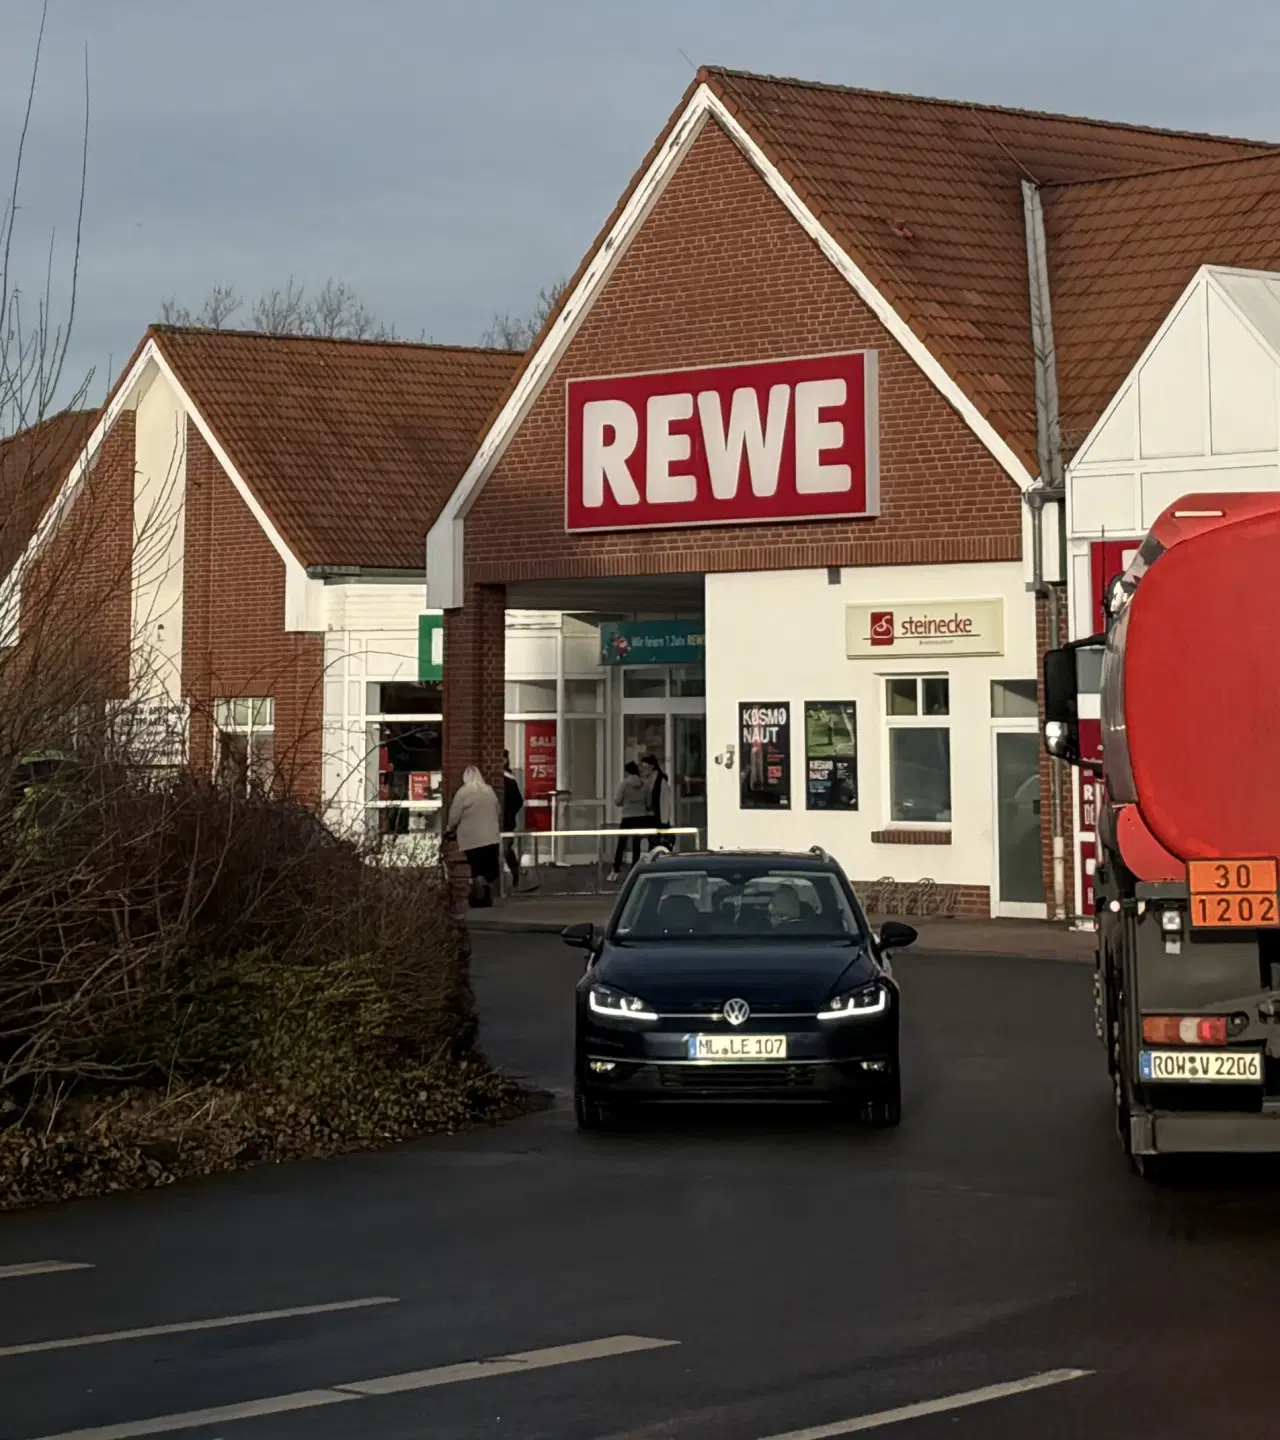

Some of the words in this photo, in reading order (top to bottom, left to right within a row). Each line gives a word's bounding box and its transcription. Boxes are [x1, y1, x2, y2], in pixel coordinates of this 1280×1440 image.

[582, 377, 852, 508] REWE
[901, 613, 973, 636] steinecke
[742, 726, 780, 744] NAUT
[1214, 864, 1252, 890] 30
[1198, 897, 1275, 924] 1202
[755, 1038, 784, 1055] 107
[1153, 1055, 1186, 1076] ROW
[1199, 1056, 1210, 1076] V
[1214, 1056, 1258, 1076] 2206
